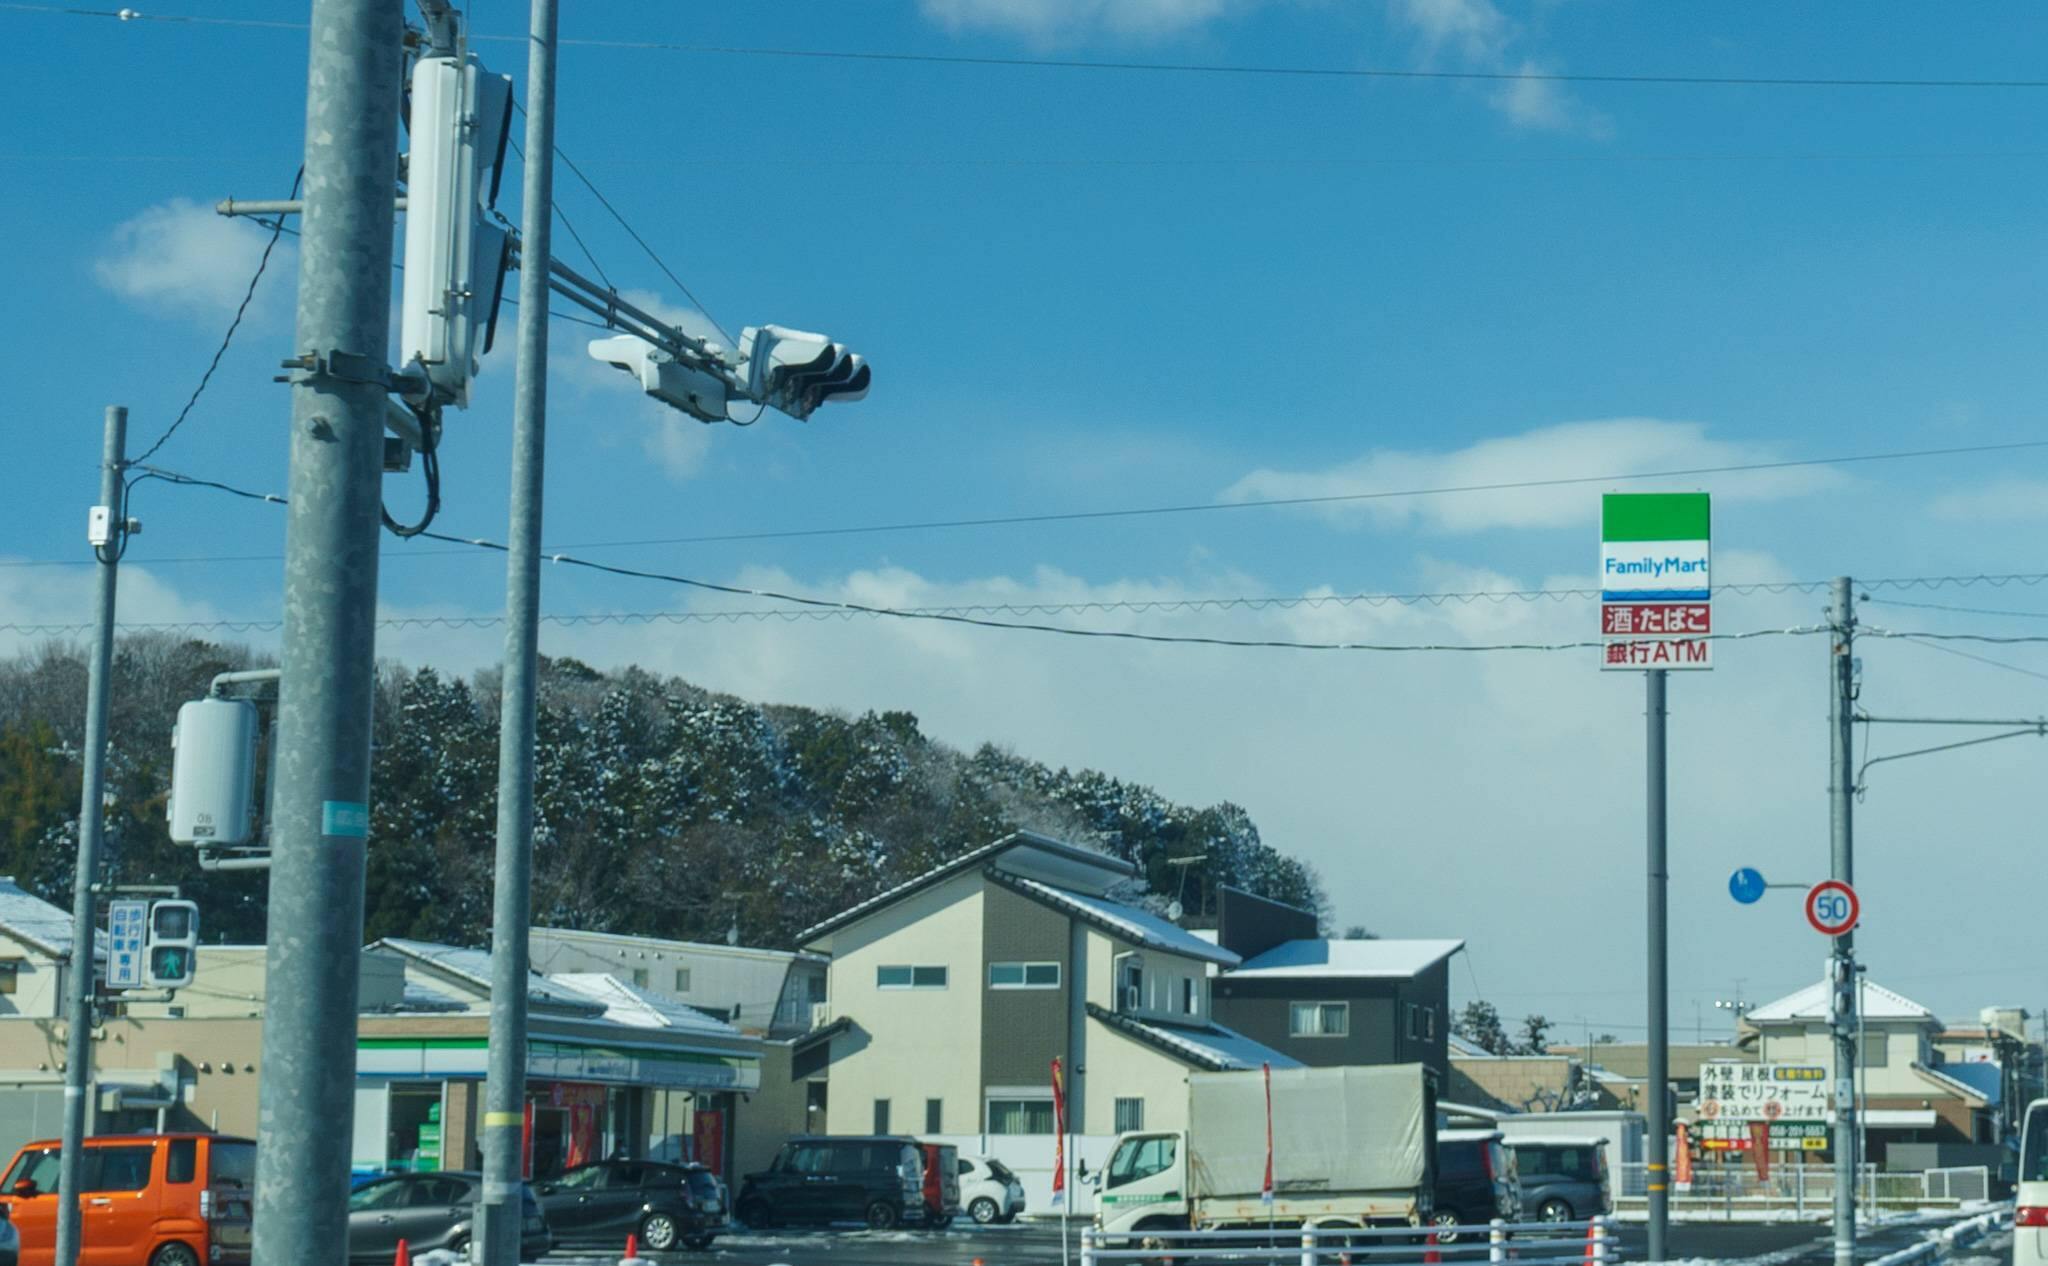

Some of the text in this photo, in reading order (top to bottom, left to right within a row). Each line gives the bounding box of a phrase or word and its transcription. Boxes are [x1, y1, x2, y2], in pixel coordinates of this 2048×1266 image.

[1605, 557, 1708, 578] FamilyMart
[1606, 641, 1707, 664] 銀行ATM
[1817, 895, 1848, 920] 50
